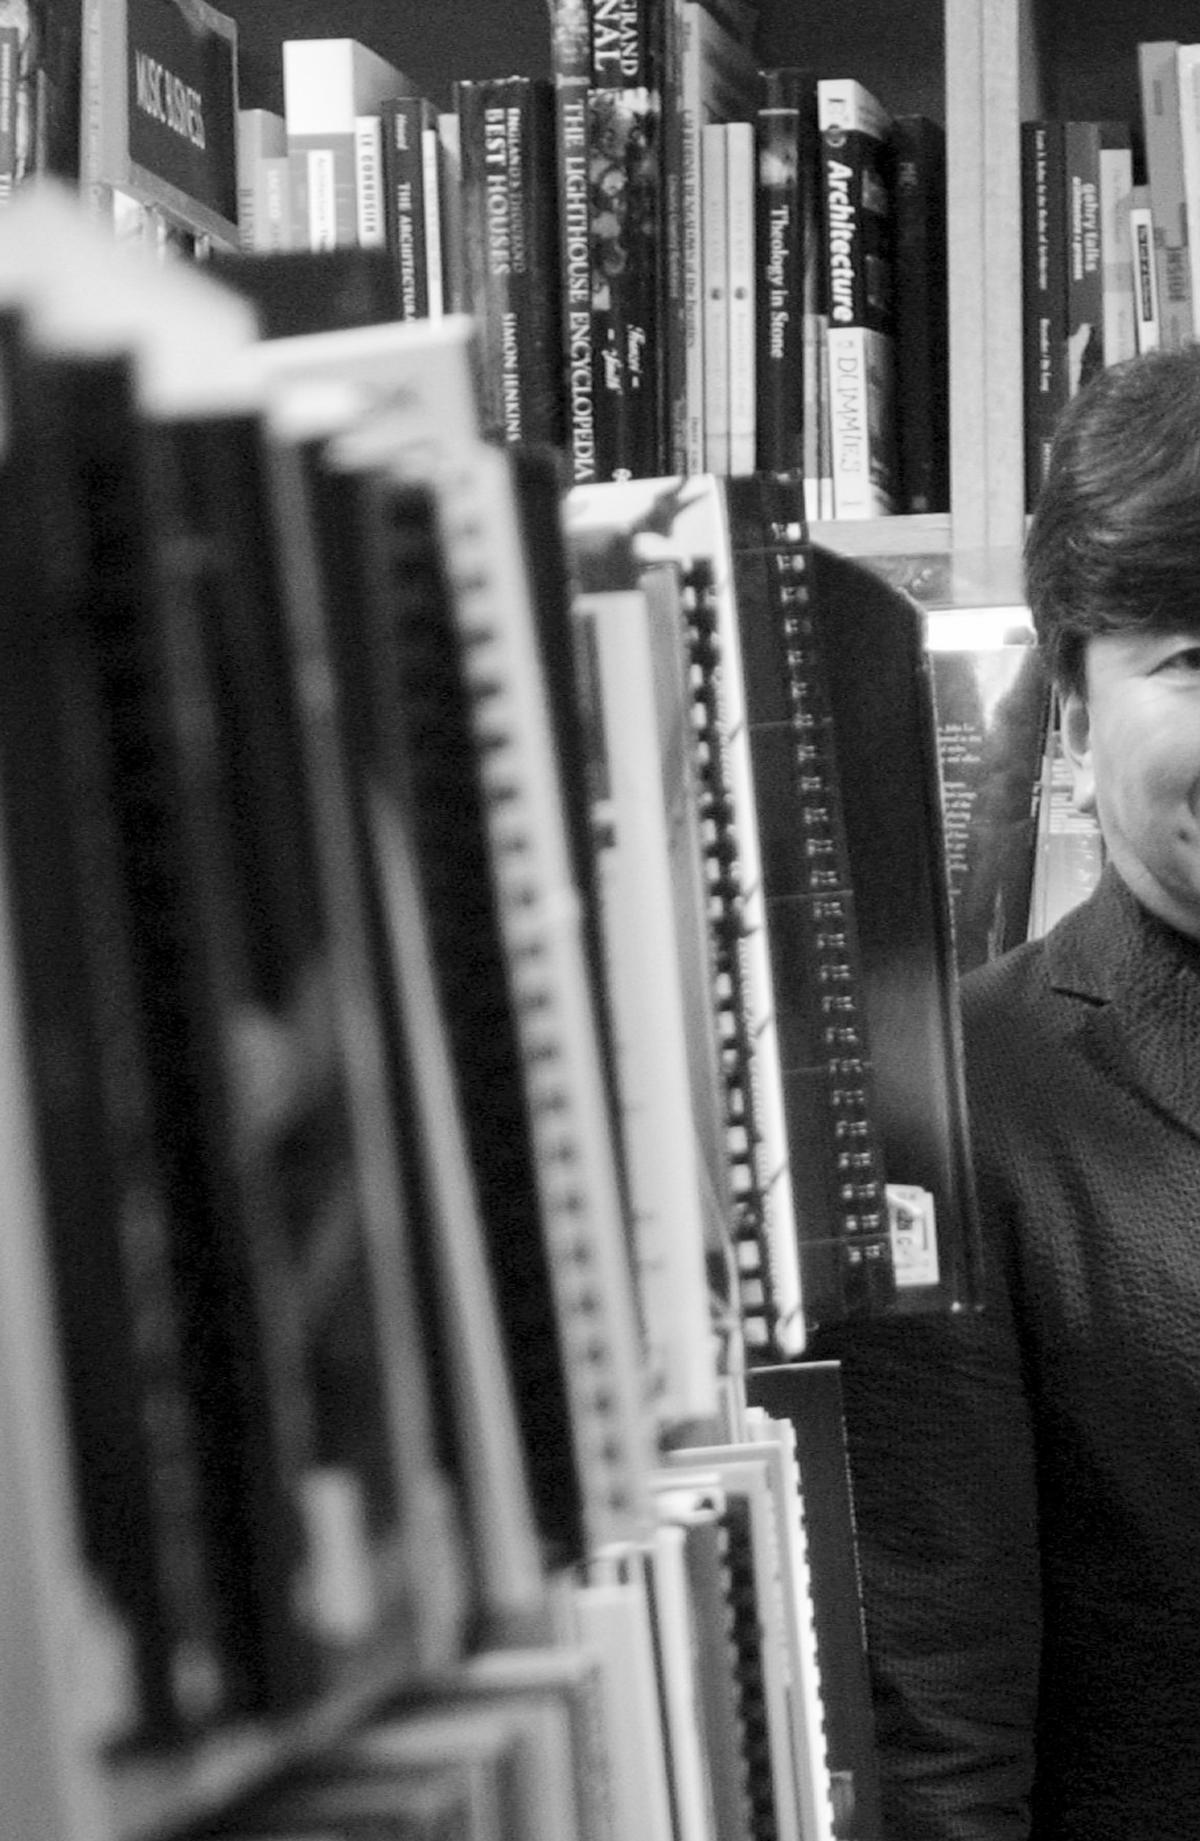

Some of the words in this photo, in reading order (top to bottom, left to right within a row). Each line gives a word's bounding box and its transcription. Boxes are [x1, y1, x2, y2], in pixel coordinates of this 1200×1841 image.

[485, 107, 507, 166] BEST
[563, 99, 586, 149] THE
[397, 182, 412, 210] THE
[486, 174, 510, 276] HOUSES
[565, 157, 589, 303] LIGHTHOUSE
[766, 204, 789, 286] Theology
[827, 159, 856, 322] Architecture
[1084, 231, 1100, 271] talks
[770, 290, 788, 306] in
[502, 312, 519, 369] SIMON
[769, 311, 789, 359] Stone
[503, 373, 522, 442] JENKINS
[569, 312, 595, 480] ENCYCLOPEDIA
[836, 356, 862, 473] DUMMIES
